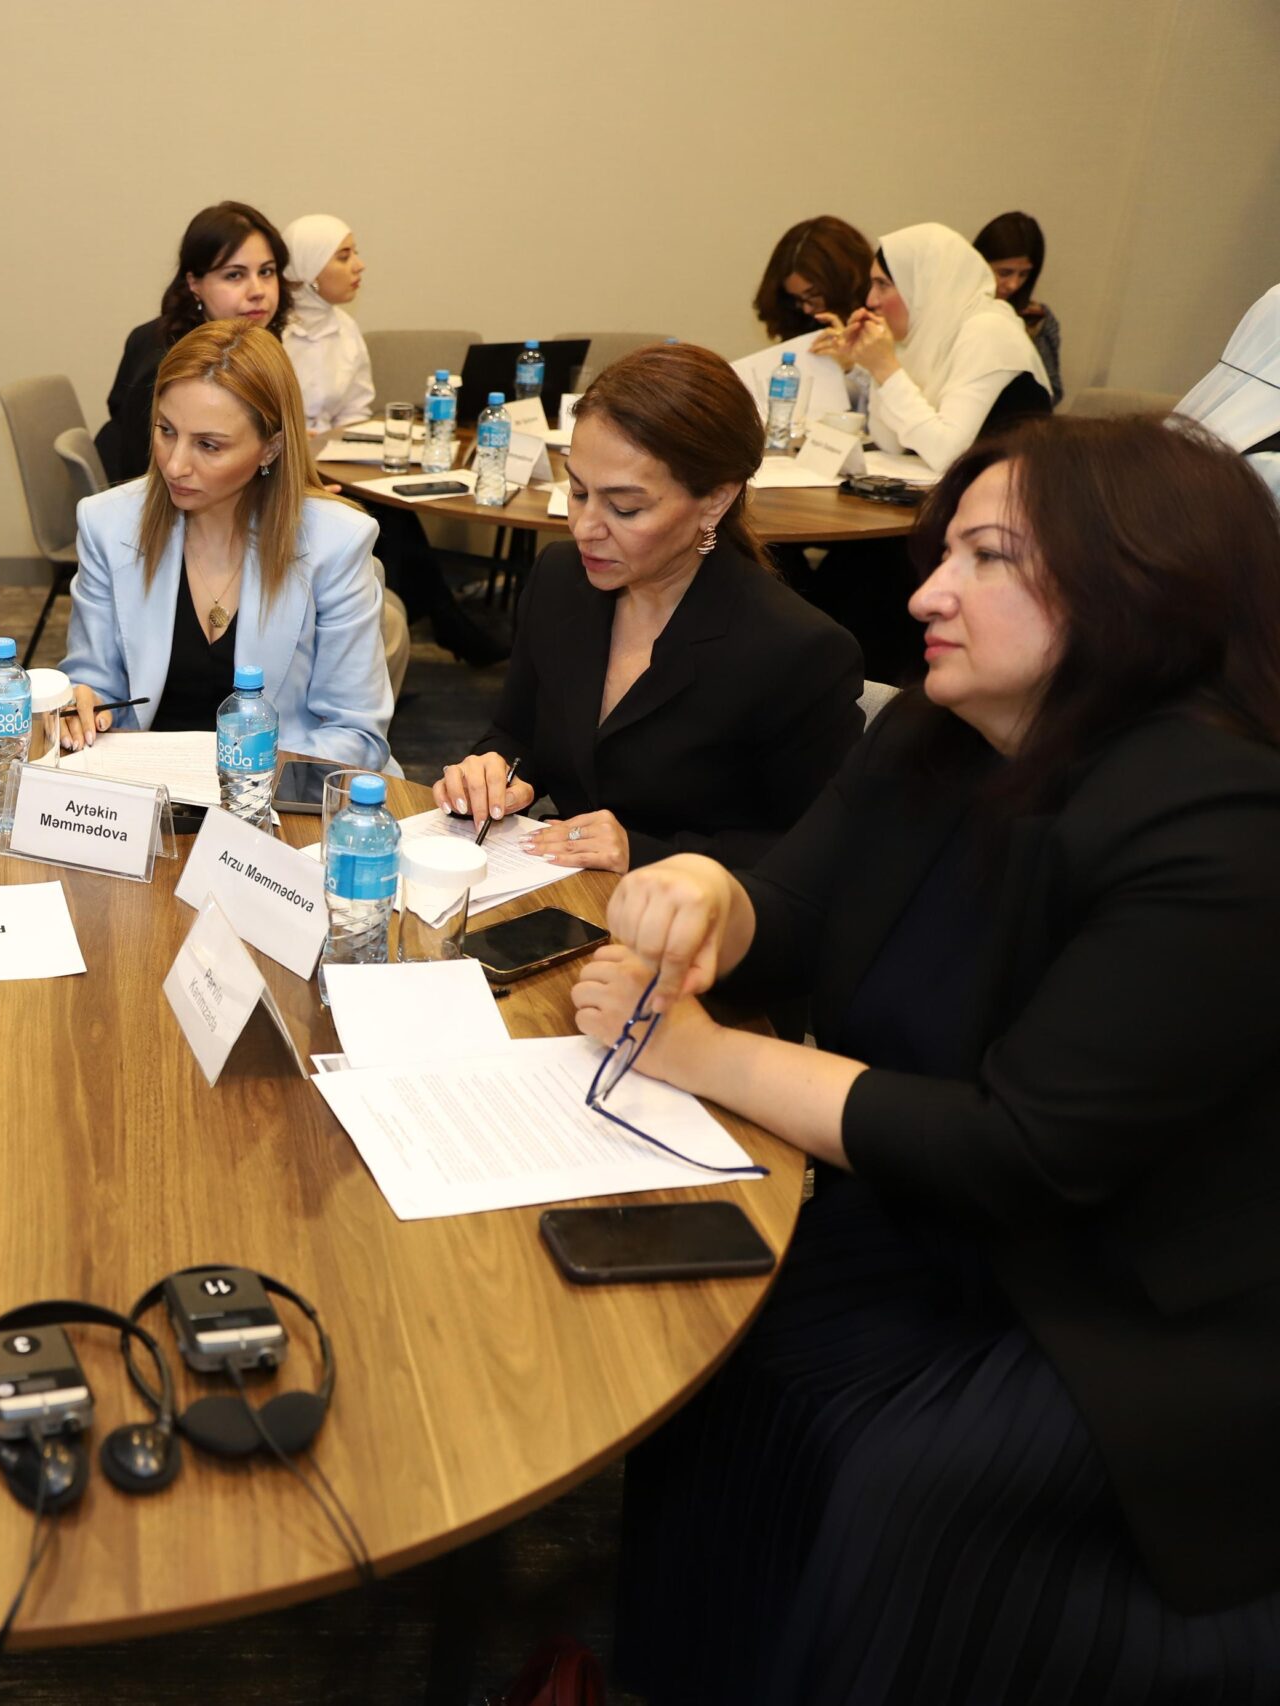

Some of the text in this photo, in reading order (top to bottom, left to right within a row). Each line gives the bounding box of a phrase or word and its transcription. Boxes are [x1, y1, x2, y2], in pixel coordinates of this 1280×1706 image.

[65, 800, 118, 821] Aytəkin
[40, 813, 128, 842] Məmmədova
[219, 850, 315, 913] Arzu Məmmədova
[204, 1280, 231, 1295] 11
